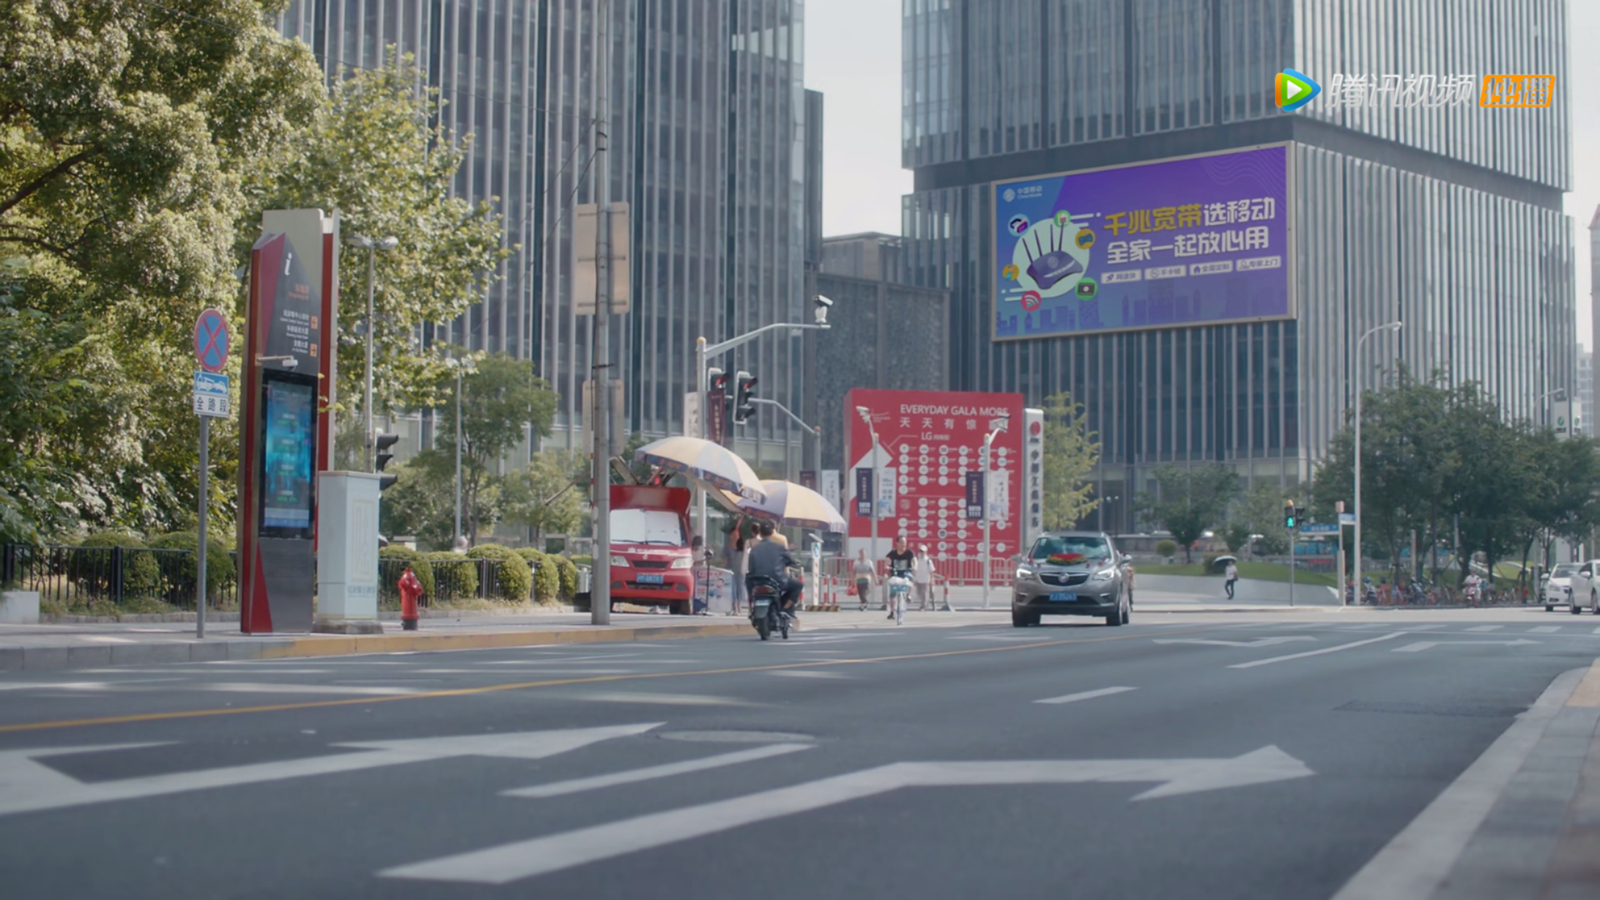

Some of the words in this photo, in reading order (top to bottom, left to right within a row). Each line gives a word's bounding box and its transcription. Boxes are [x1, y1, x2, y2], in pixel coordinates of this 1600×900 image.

[1017, 185, 1043, 195] 中国移动
[1103, 197, 1276, 237] 千兆宽带选移动
[1106, 225, 1270, 265] 全家一起放心用
[1249, 258, 1279, 269] 专家上门
[196, 396, 228, 413] 全路段
[900, 404, 949, 415] EVERYDAY
[950, 406, 977, 416] GALA
[979, 406, 1009, 417] MORE
[921, 431, 933, 441] LG
